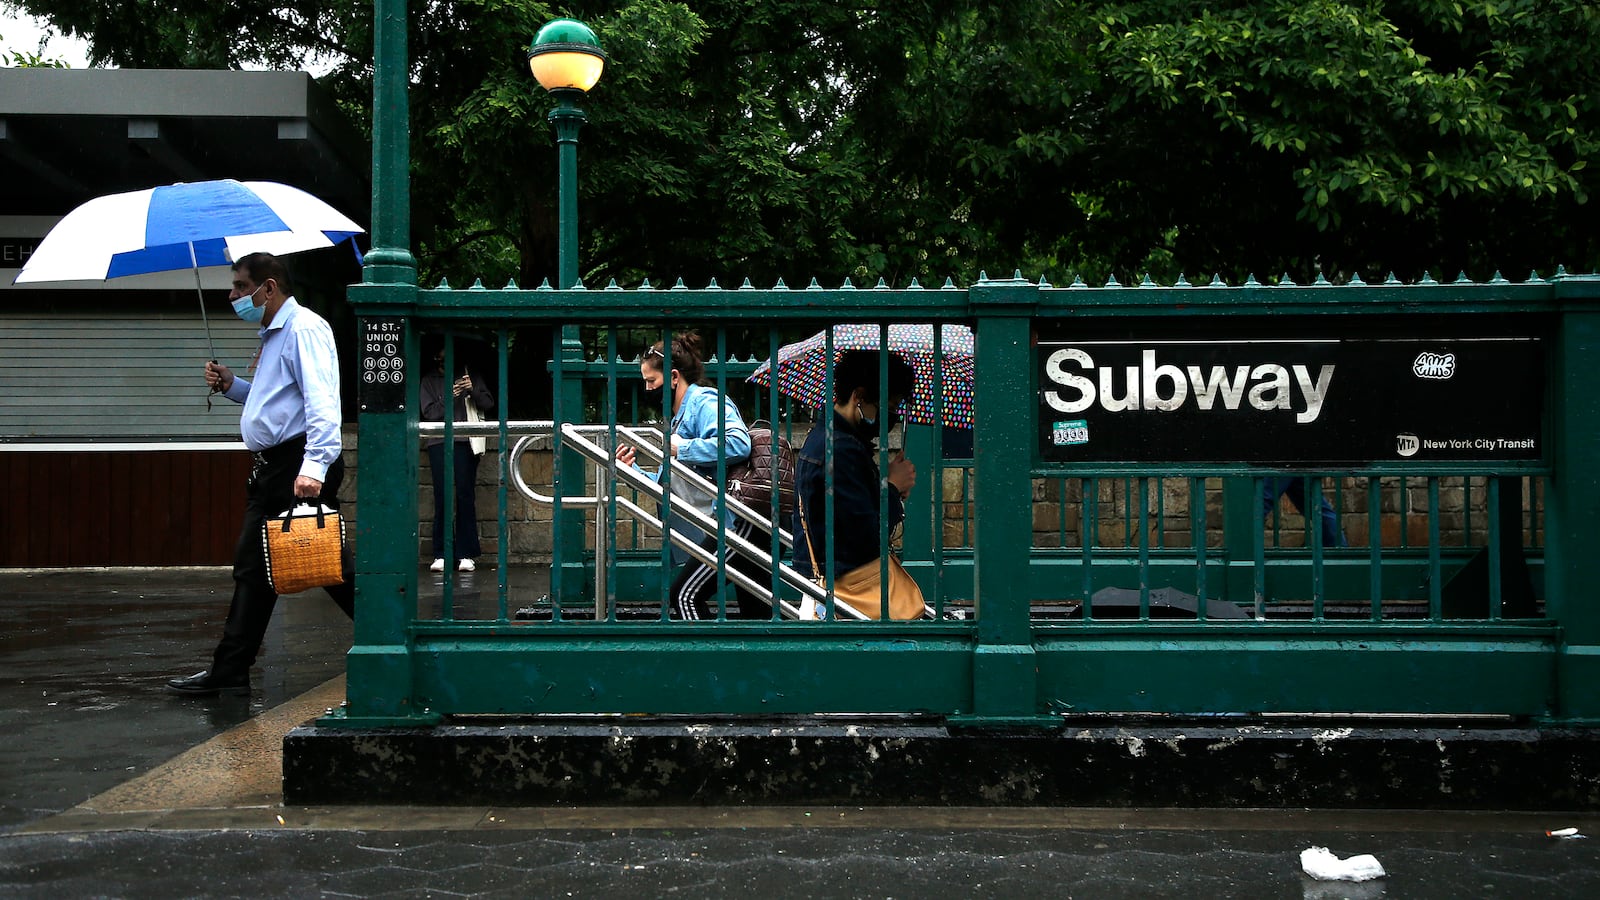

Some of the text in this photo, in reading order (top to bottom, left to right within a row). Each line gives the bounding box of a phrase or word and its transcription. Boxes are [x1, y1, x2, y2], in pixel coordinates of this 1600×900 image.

[367, 323, 378, 331] 14
[366, 333, 399, 342] UNION
[366, 343, 381, 352] SQ
[1044, 348, 1335, 423] Subway
[1396, 438, 1417, 451] MTA
[1423, 438, 1535, 451] New York City Transit
